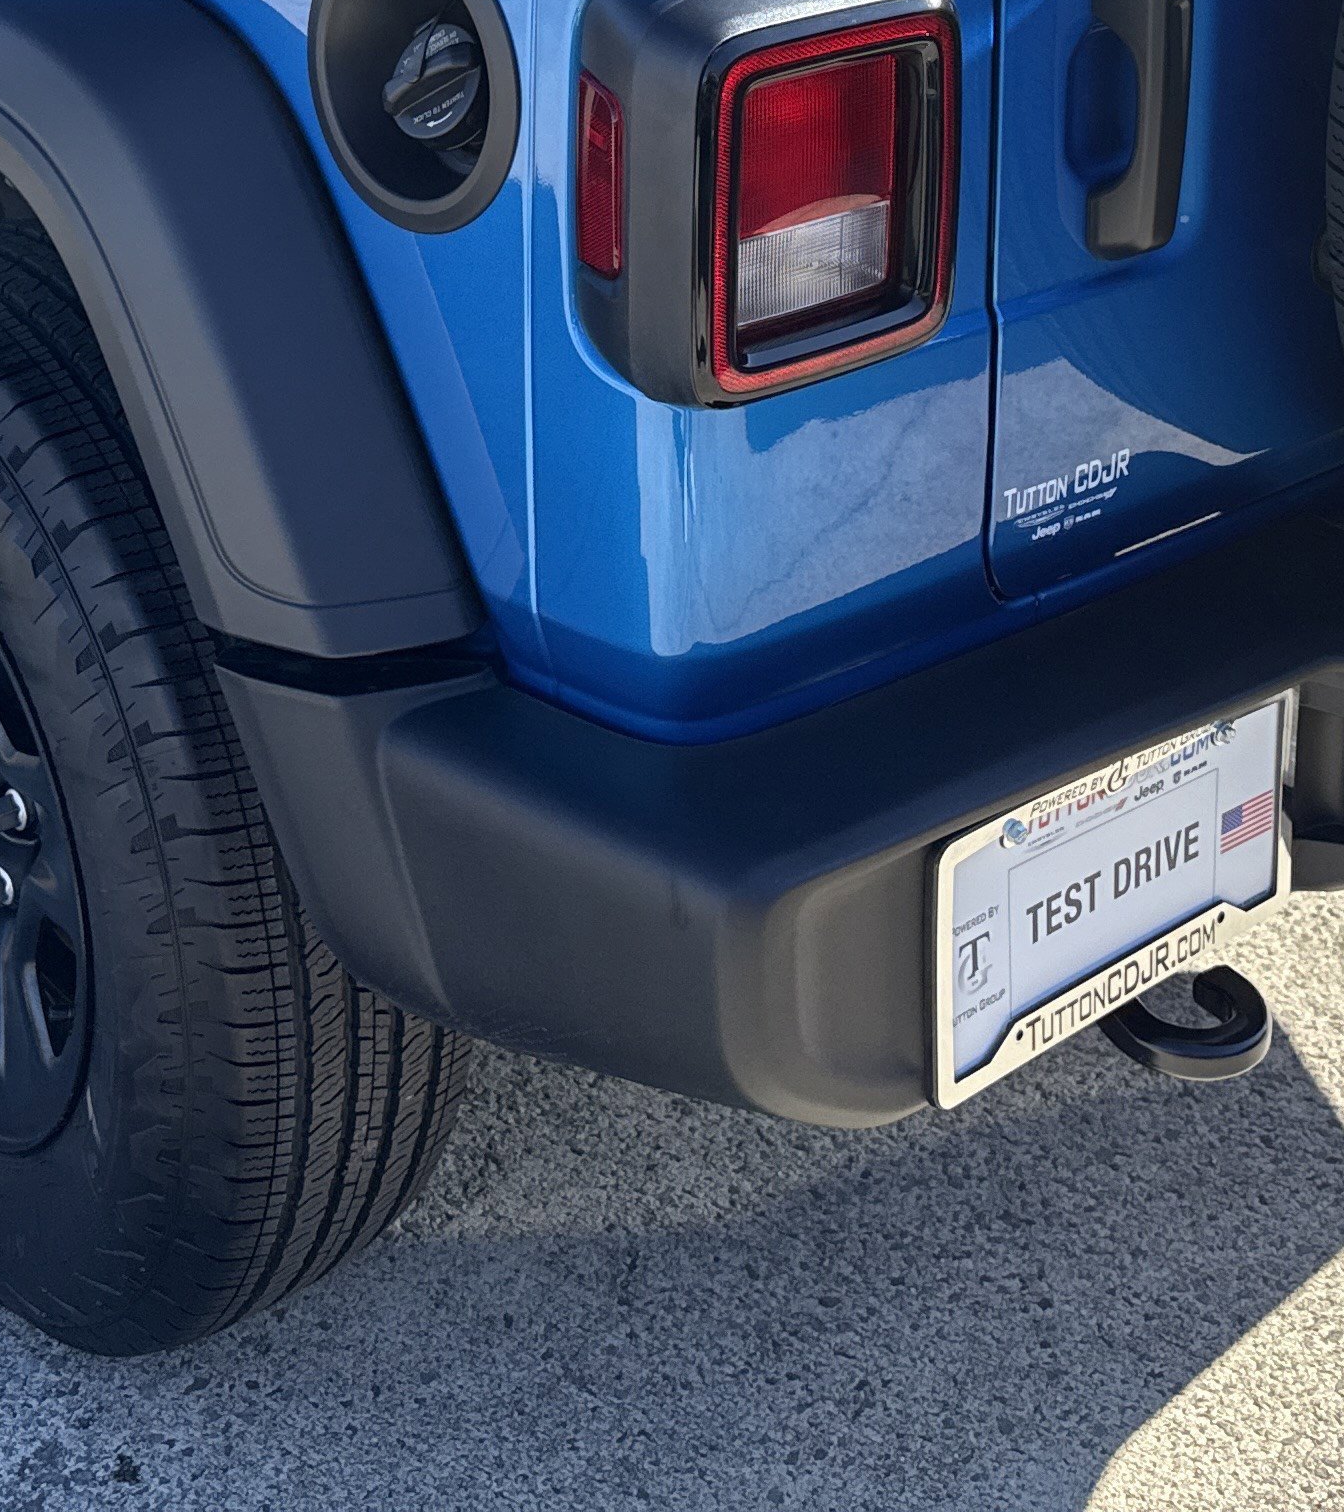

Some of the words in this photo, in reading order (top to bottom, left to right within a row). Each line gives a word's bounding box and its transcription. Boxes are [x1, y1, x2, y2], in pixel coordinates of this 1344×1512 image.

[1003, 474, 1068, 518] TUTTON
[1074, 448, 1130, 494] CDJR
[1031, 522, 1061, 541] Jeep
[1029, 782, 1087, 816] POWERED
[1090, 774, 1106, 792] BY
[1134, 778, 1165, 802] Jeep
[1184, 760, 1208, 776] RAM
[1025, 870, 1102, 945] TEST
[1113, 821, 1200, 900] DRIVE
